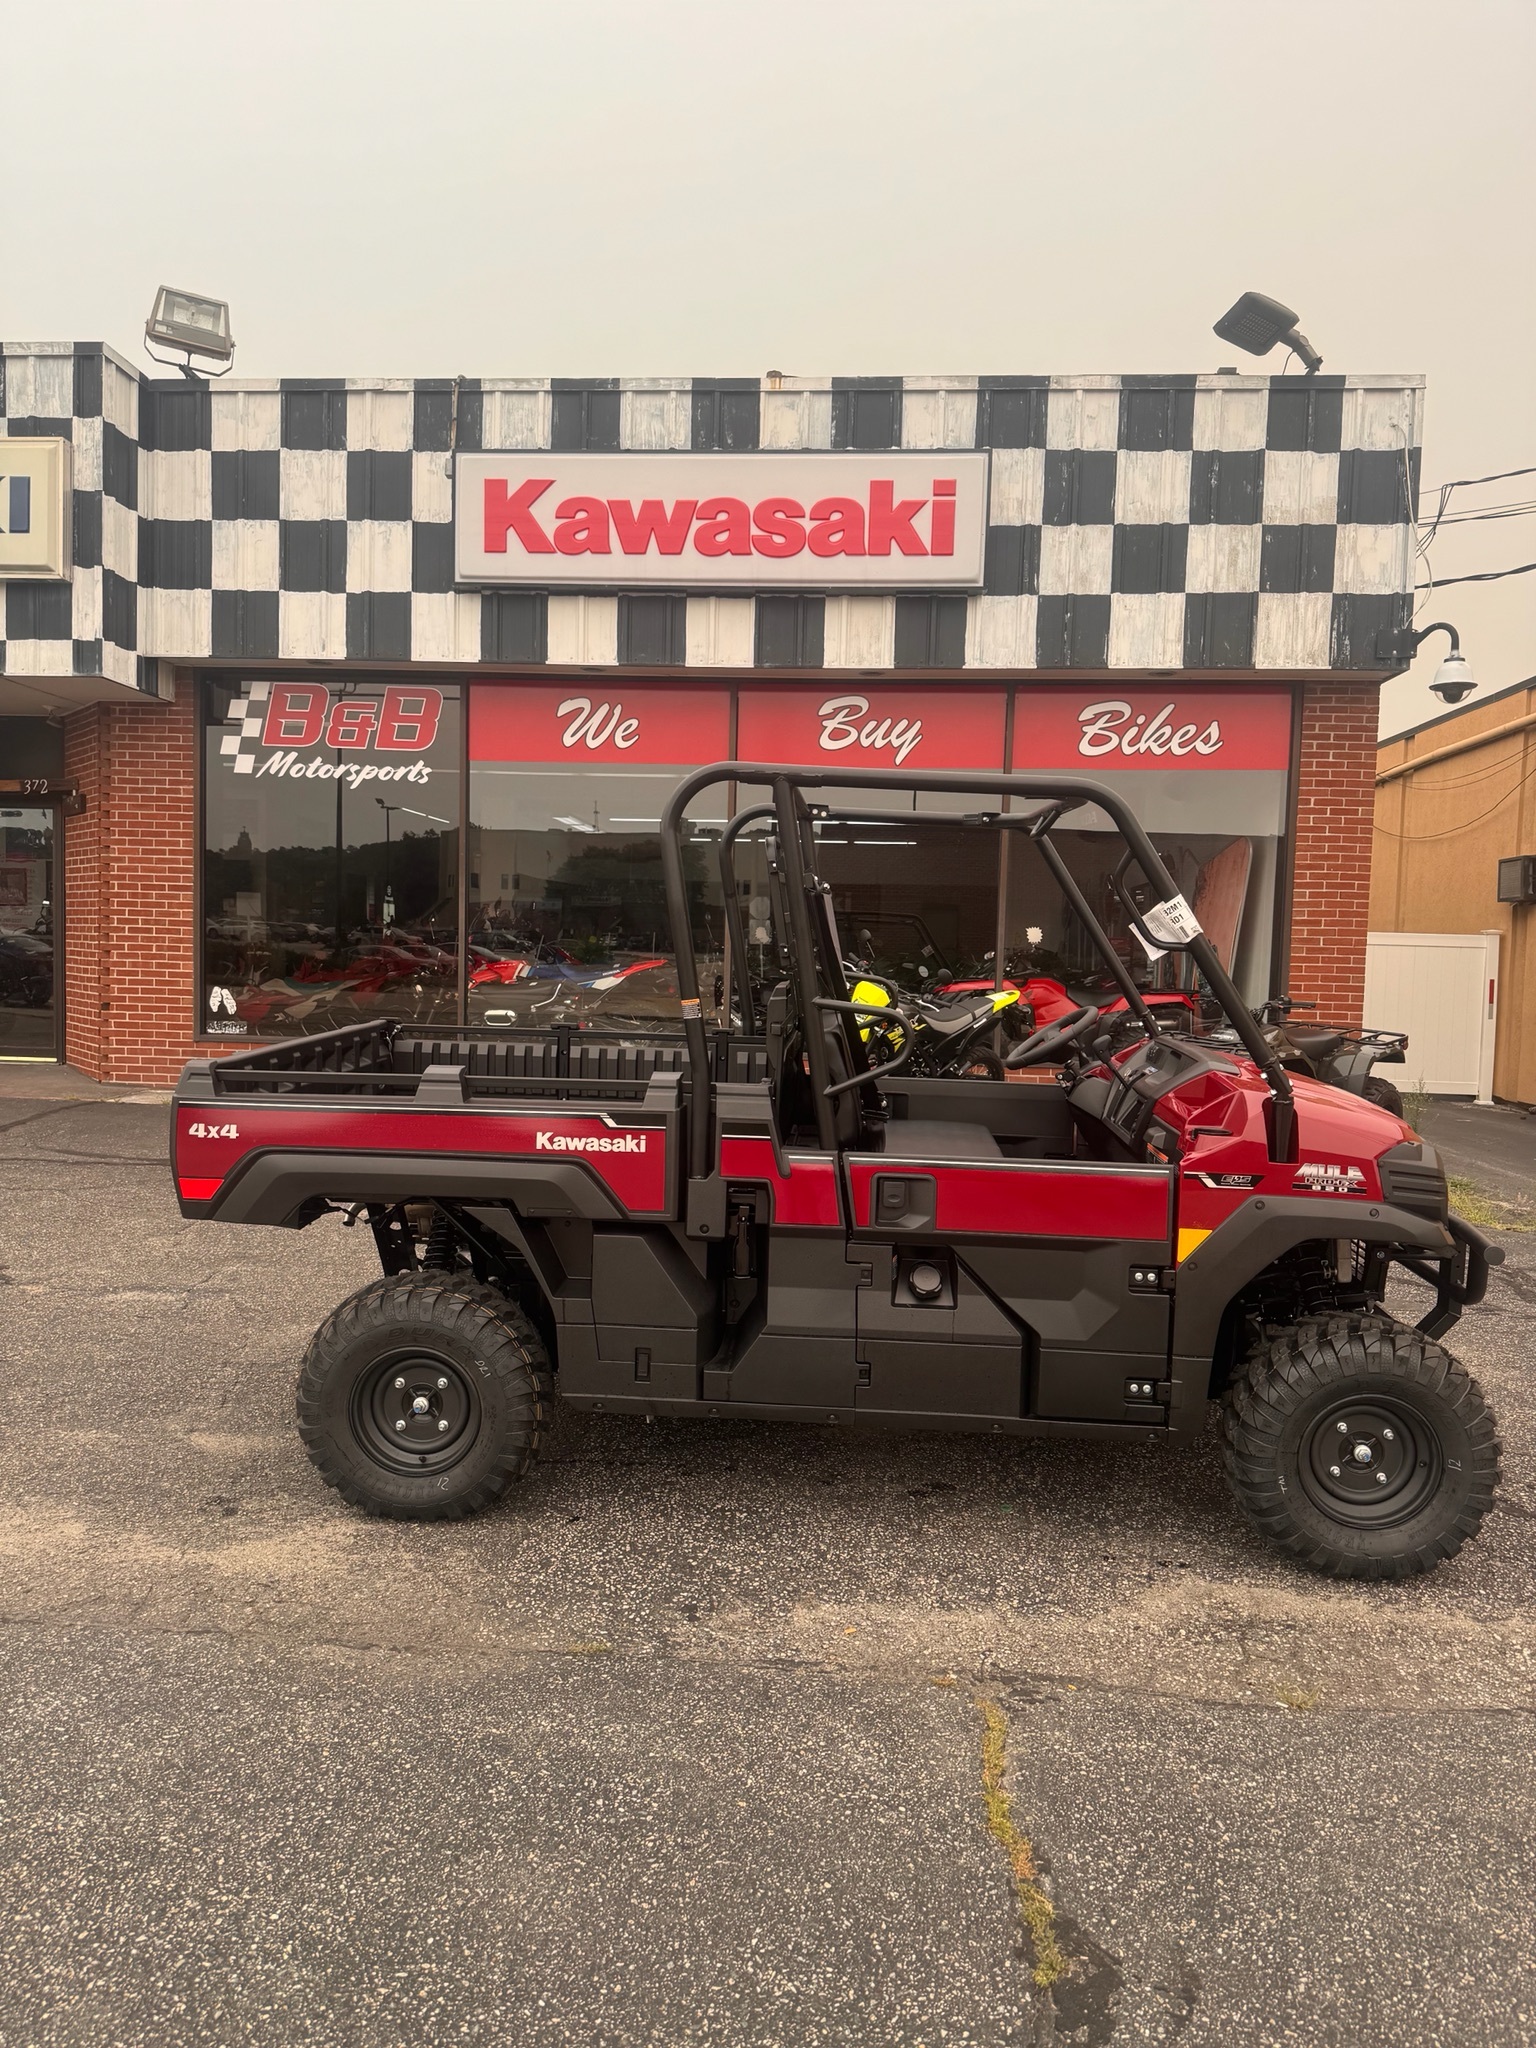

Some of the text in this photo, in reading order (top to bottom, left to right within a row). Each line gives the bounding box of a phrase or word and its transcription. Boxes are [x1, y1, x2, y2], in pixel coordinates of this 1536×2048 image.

[484, 478, 957, 558] Kawasaki
[262, 682, 443, 751] B&B
[556, 695, 1224, 766] We Buy Bikes
[255, 751, 433, 789] Motorsports
[24, 779, 48, 795] 372
[188, 1123, 240, 1140] 4x4
[535, 1131, 647, 1154] Kawasaki
[1294, 1162, 1367, 1181] MULE
